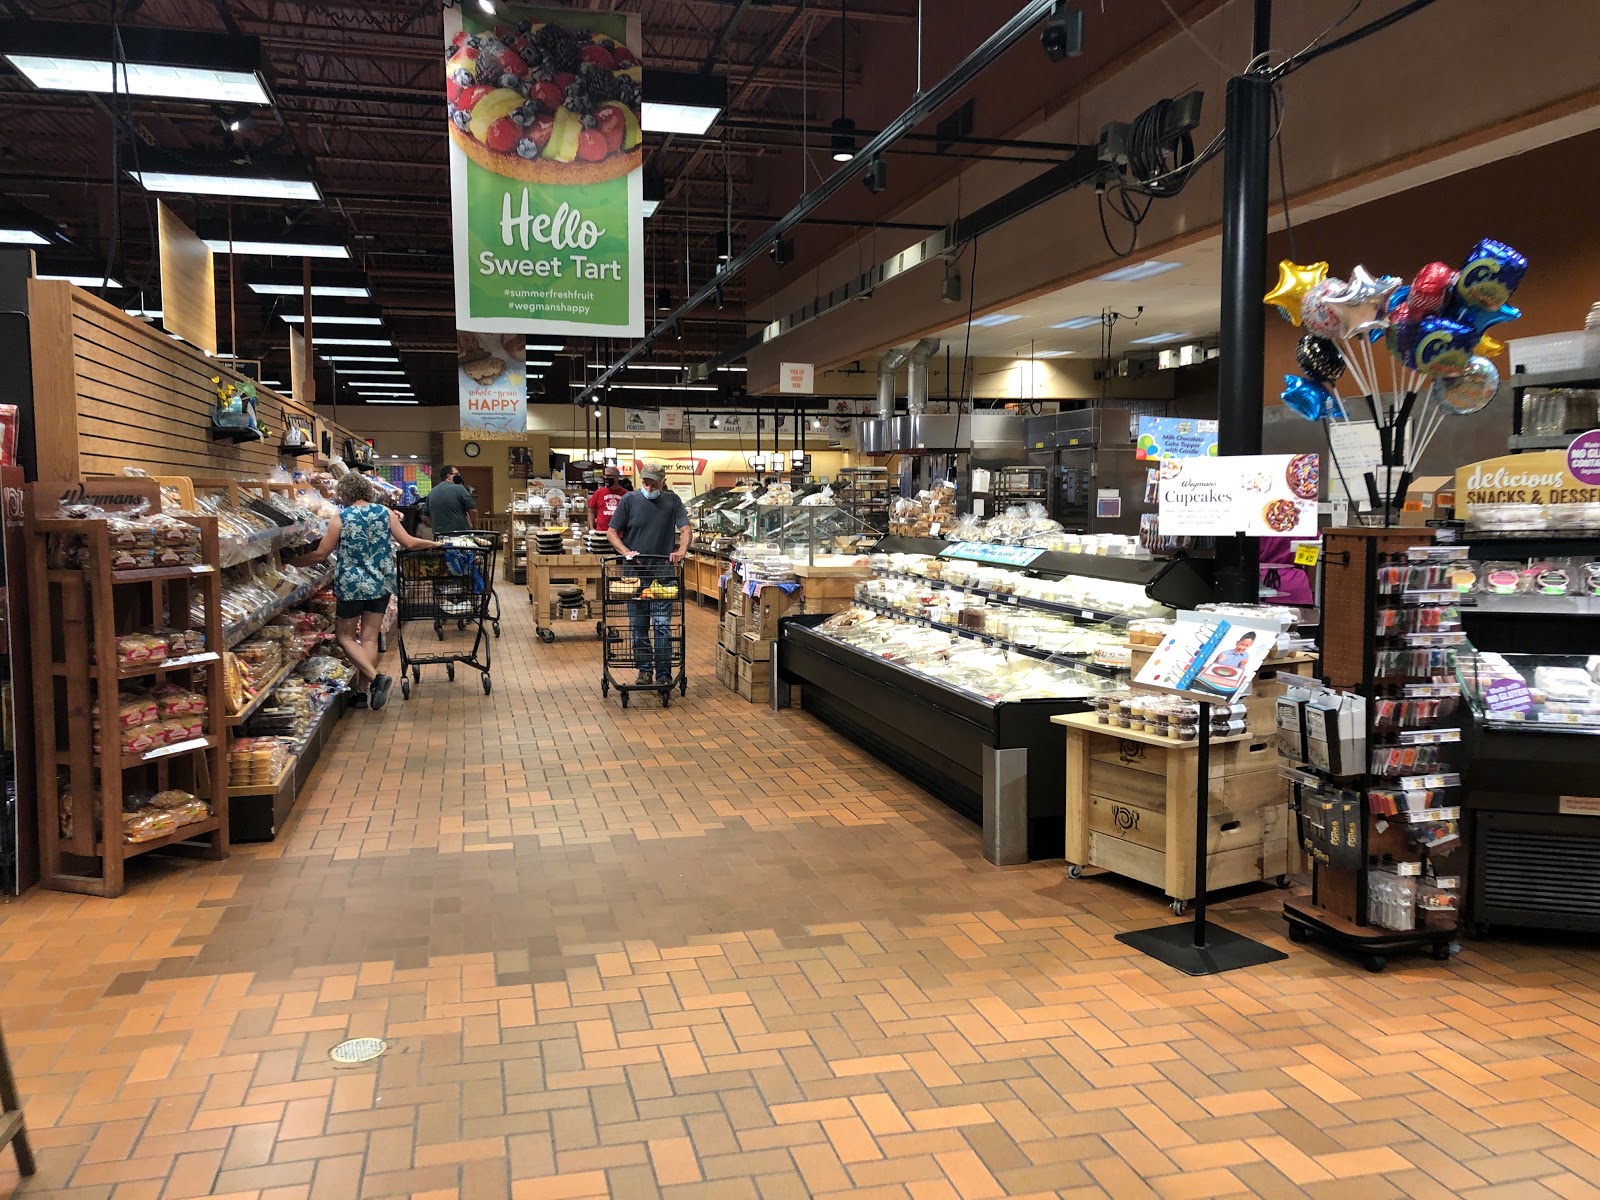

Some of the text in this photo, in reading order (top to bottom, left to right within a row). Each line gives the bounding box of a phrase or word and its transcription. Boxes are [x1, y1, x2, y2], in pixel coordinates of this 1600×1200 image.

[500, 186, 606, 251] Hello
[479, 251, 622, 281] Sweet Tart
[504, 288, 594, 300] #summerfreshfruit
[508, 301, 590, 315] #wegmanshappy
[468, 399, 519, 412] HAPPY
[675, 463, 694, 471] Service
[1466, 465, 1564, 490] delicious
[1181, 478, 1217, 492] Wegmans
[1164, 489, 1233, 506] Cupcakes
[1466, 490, 1526, 505] SNACKS
[1531, 490, 1544, 505] &
